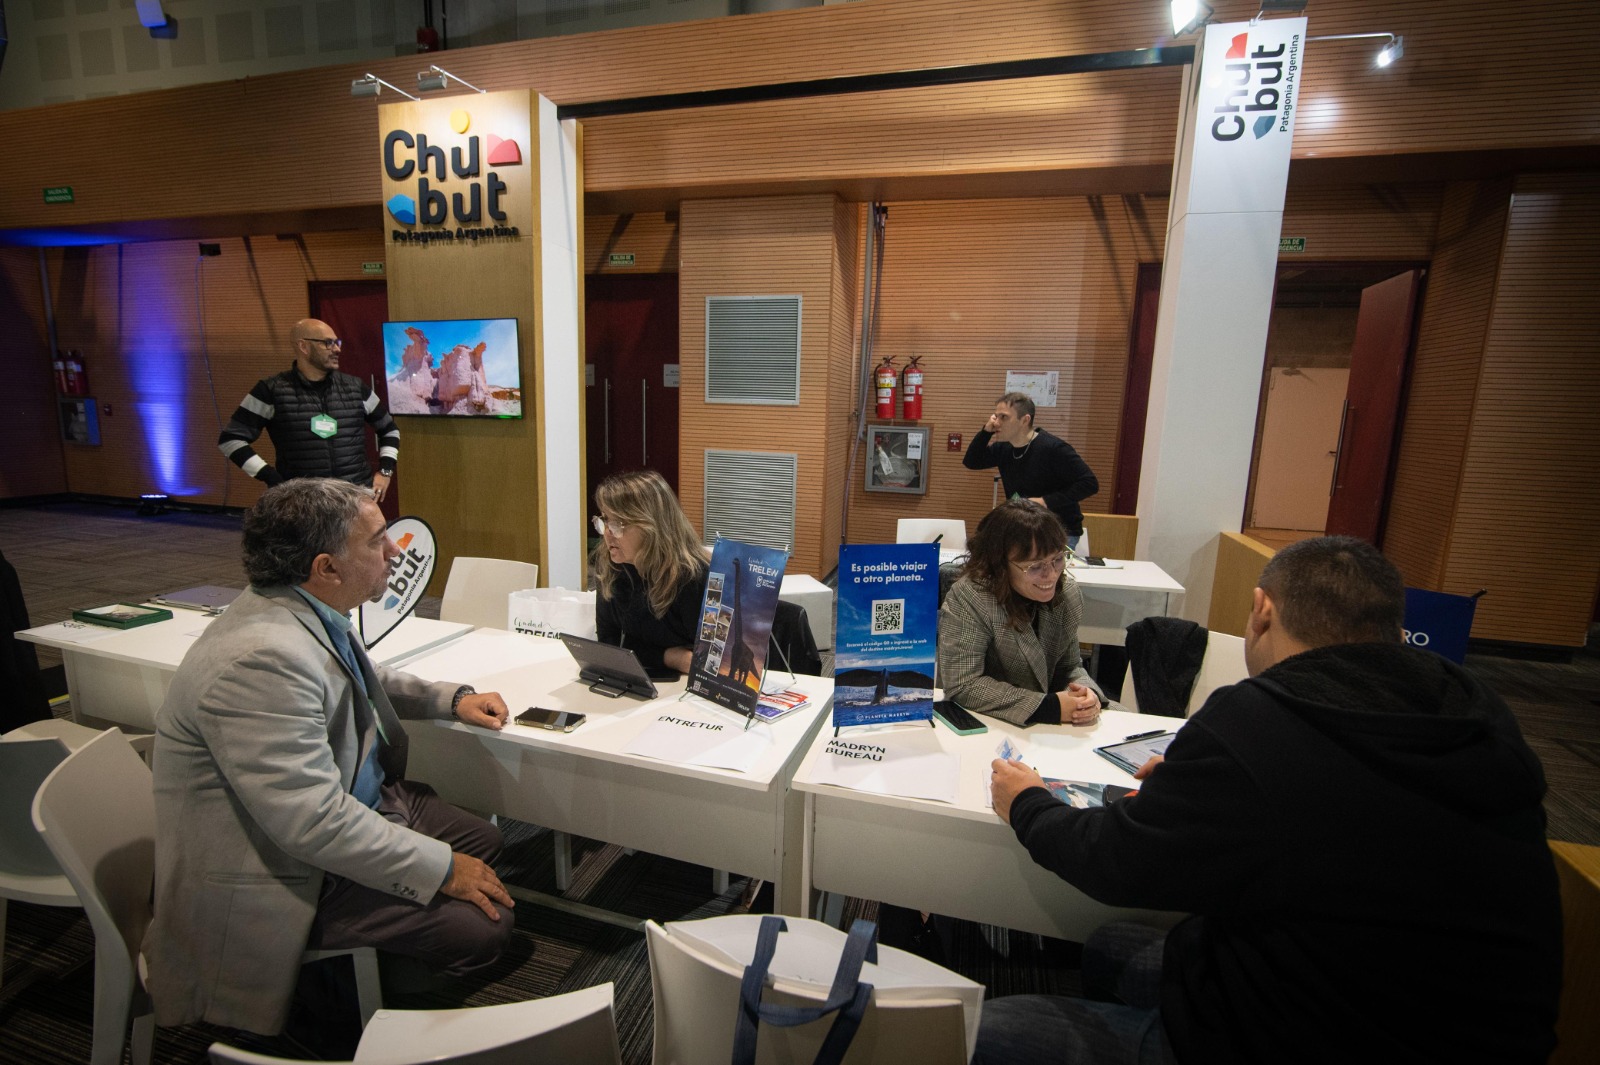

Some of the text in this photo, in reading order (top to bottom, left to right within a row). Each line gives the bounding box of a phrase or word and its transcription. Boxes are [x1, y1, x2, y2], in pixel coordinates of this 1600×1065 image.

[1245, 43, 1286, 113] but
[1279, 34, 1300, 132] Patagonia Argentina
[384, 129, 480, 181] Chu
[418, 172, 507, 225] but
[392, 224, 519, 243] Patagonia Argentina
[388, 547, 426, 597] but
[748, 563, 779, 578] TRELEW
[851, 561, 928, 575] Es posible viajar
[862, 574, 884, 583] otro
[885, 573, 924, 585] planeta.
[397, 582, 417, 615] Patagonia
[657, 715, 724, 732] ENTRETUR
[825, 747, 883, 762] BUREAU
[827, 740, 886, 754] MADRYN
